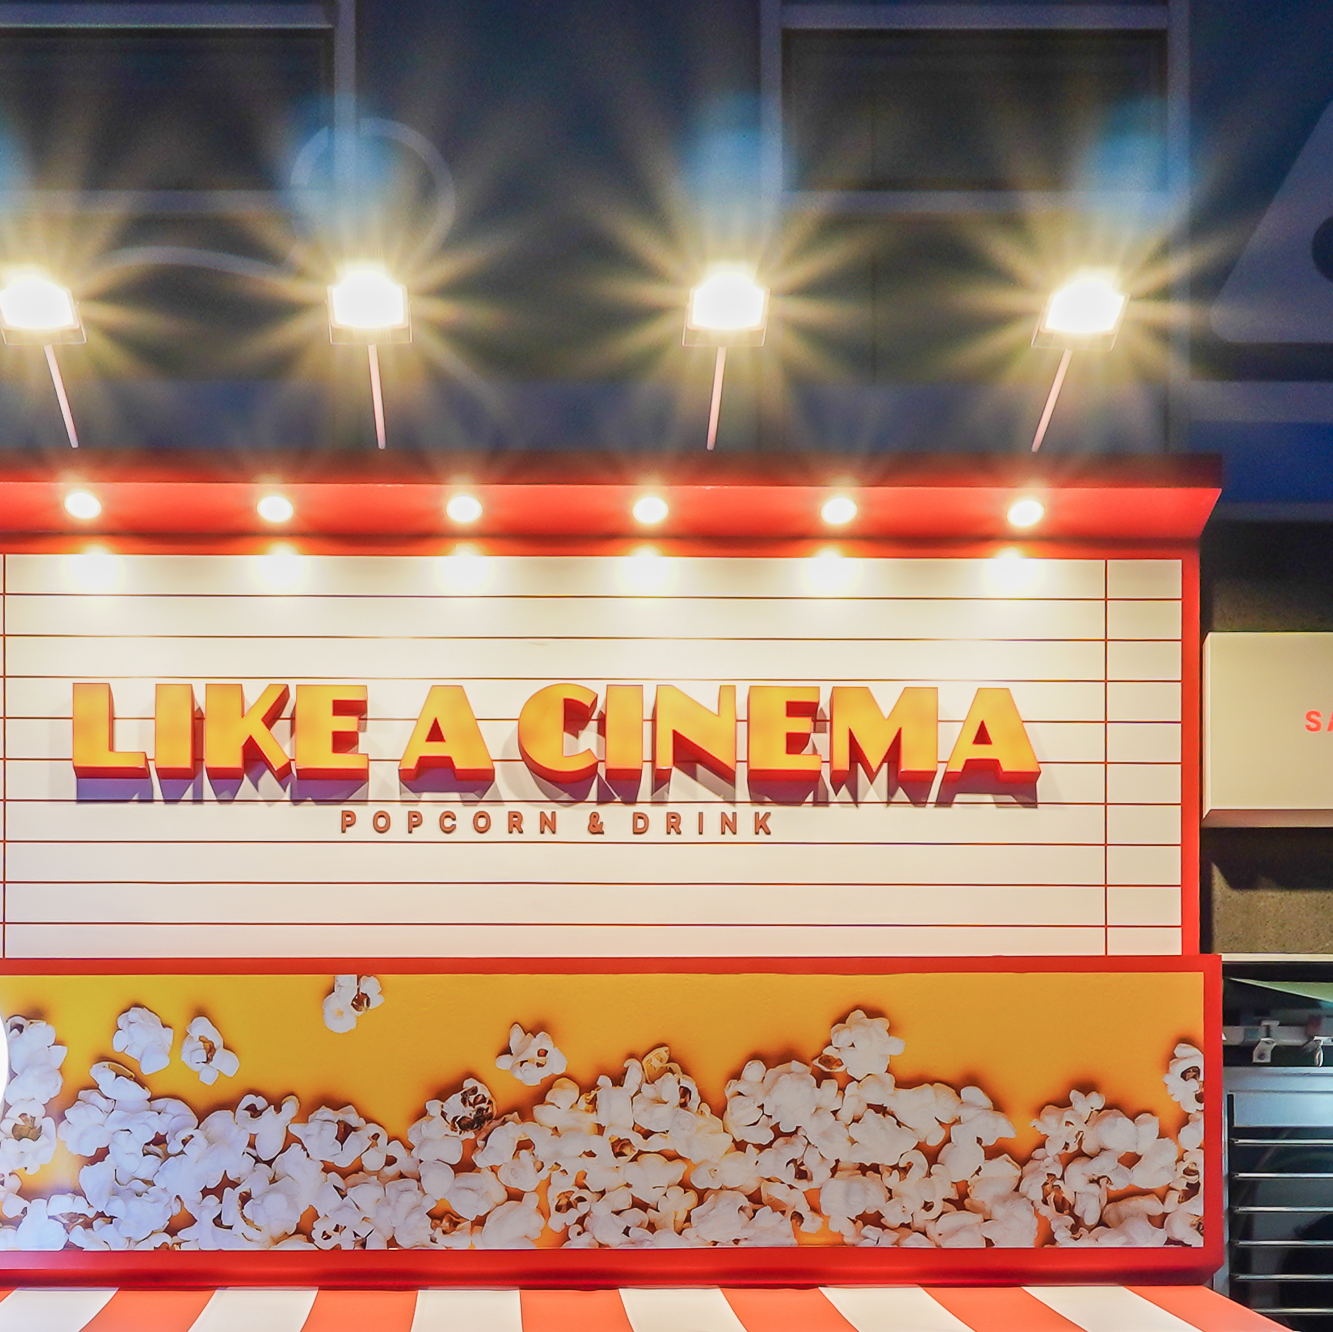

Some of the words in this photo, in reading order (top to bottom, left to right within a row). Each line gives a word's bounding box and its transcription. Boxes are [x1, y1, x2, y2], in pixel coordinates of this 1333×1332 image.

[70, 681, 371, 780] LIKE
[397, 683, 496, 782] A
[516, 682, 1042, 784] CINEMA
[340, 808, 557, 837] POPCORN
[586, 808, 607, 837] &
[630, 809, 776, 837] DRINK
